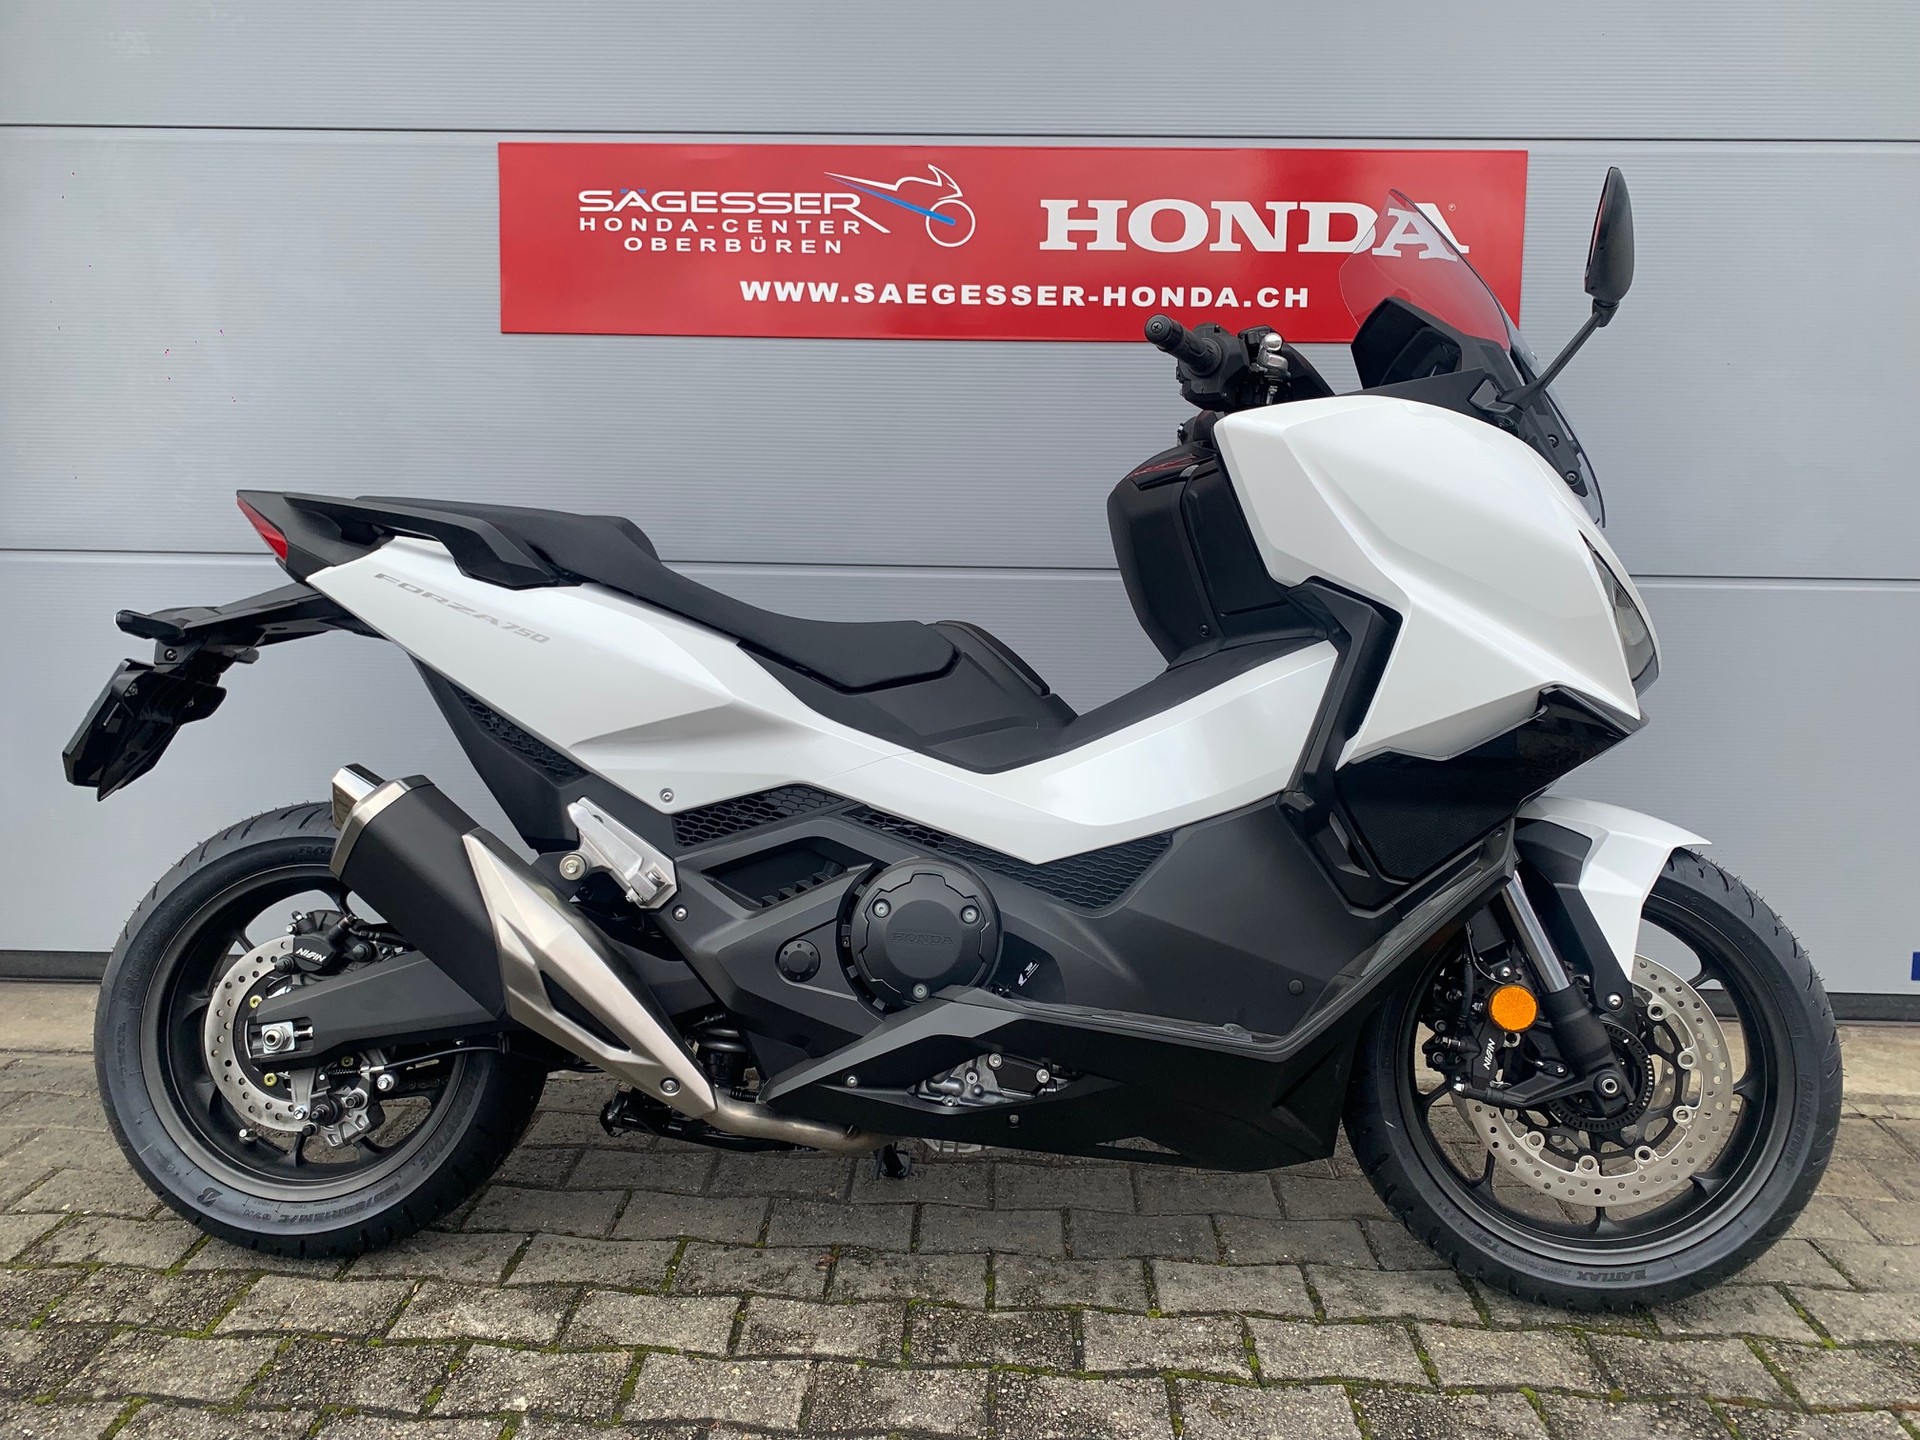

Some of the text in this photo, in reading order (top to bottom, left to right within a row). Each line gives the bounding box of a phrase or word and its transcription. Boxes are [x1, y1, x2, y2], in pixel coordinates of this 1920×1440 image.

[578, 188, 890, 233] SÄGESSER
[579, 216, 861, 235] HONDA-CENTER
[1039, 198, 1470, 262] HONDA
[624, 236, 843, 254] OBERBÜREN
[740, 280, 1309, 308] WWW.SAEGESSER-HONDA.CH
[891, 931, 957, 947] HONDA
